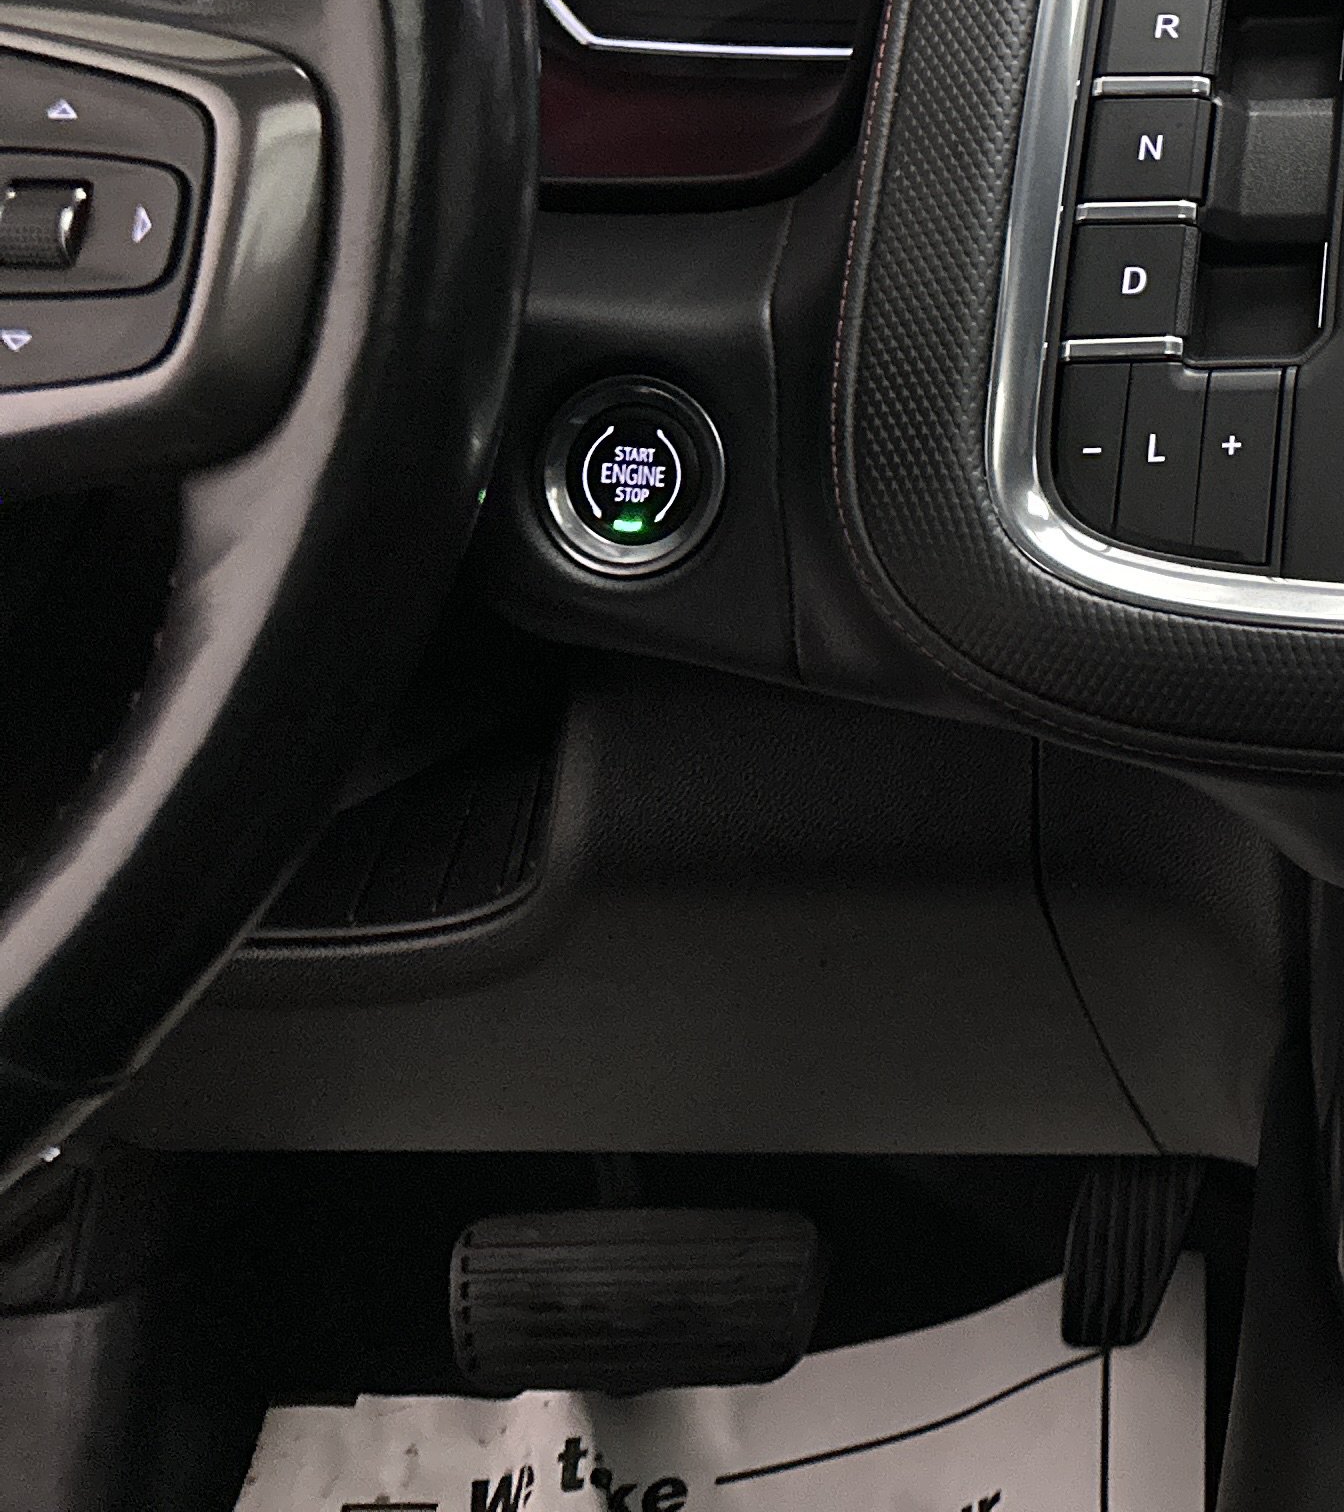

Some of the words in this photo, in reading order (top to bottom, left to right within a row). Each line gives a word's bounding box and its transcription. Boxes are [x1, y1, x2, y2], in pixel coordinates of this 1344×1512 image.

[1155, 15, 1179, 38] R
[1138, 135, 1163, 160] N
[1122, 267, 1146, 294] D
[614, 446, 656, 462] START
[1148, 434, 1165, 462] L
[601, 462, 666, 487] ENGINE
[614, 486, 650, 502] STOP
